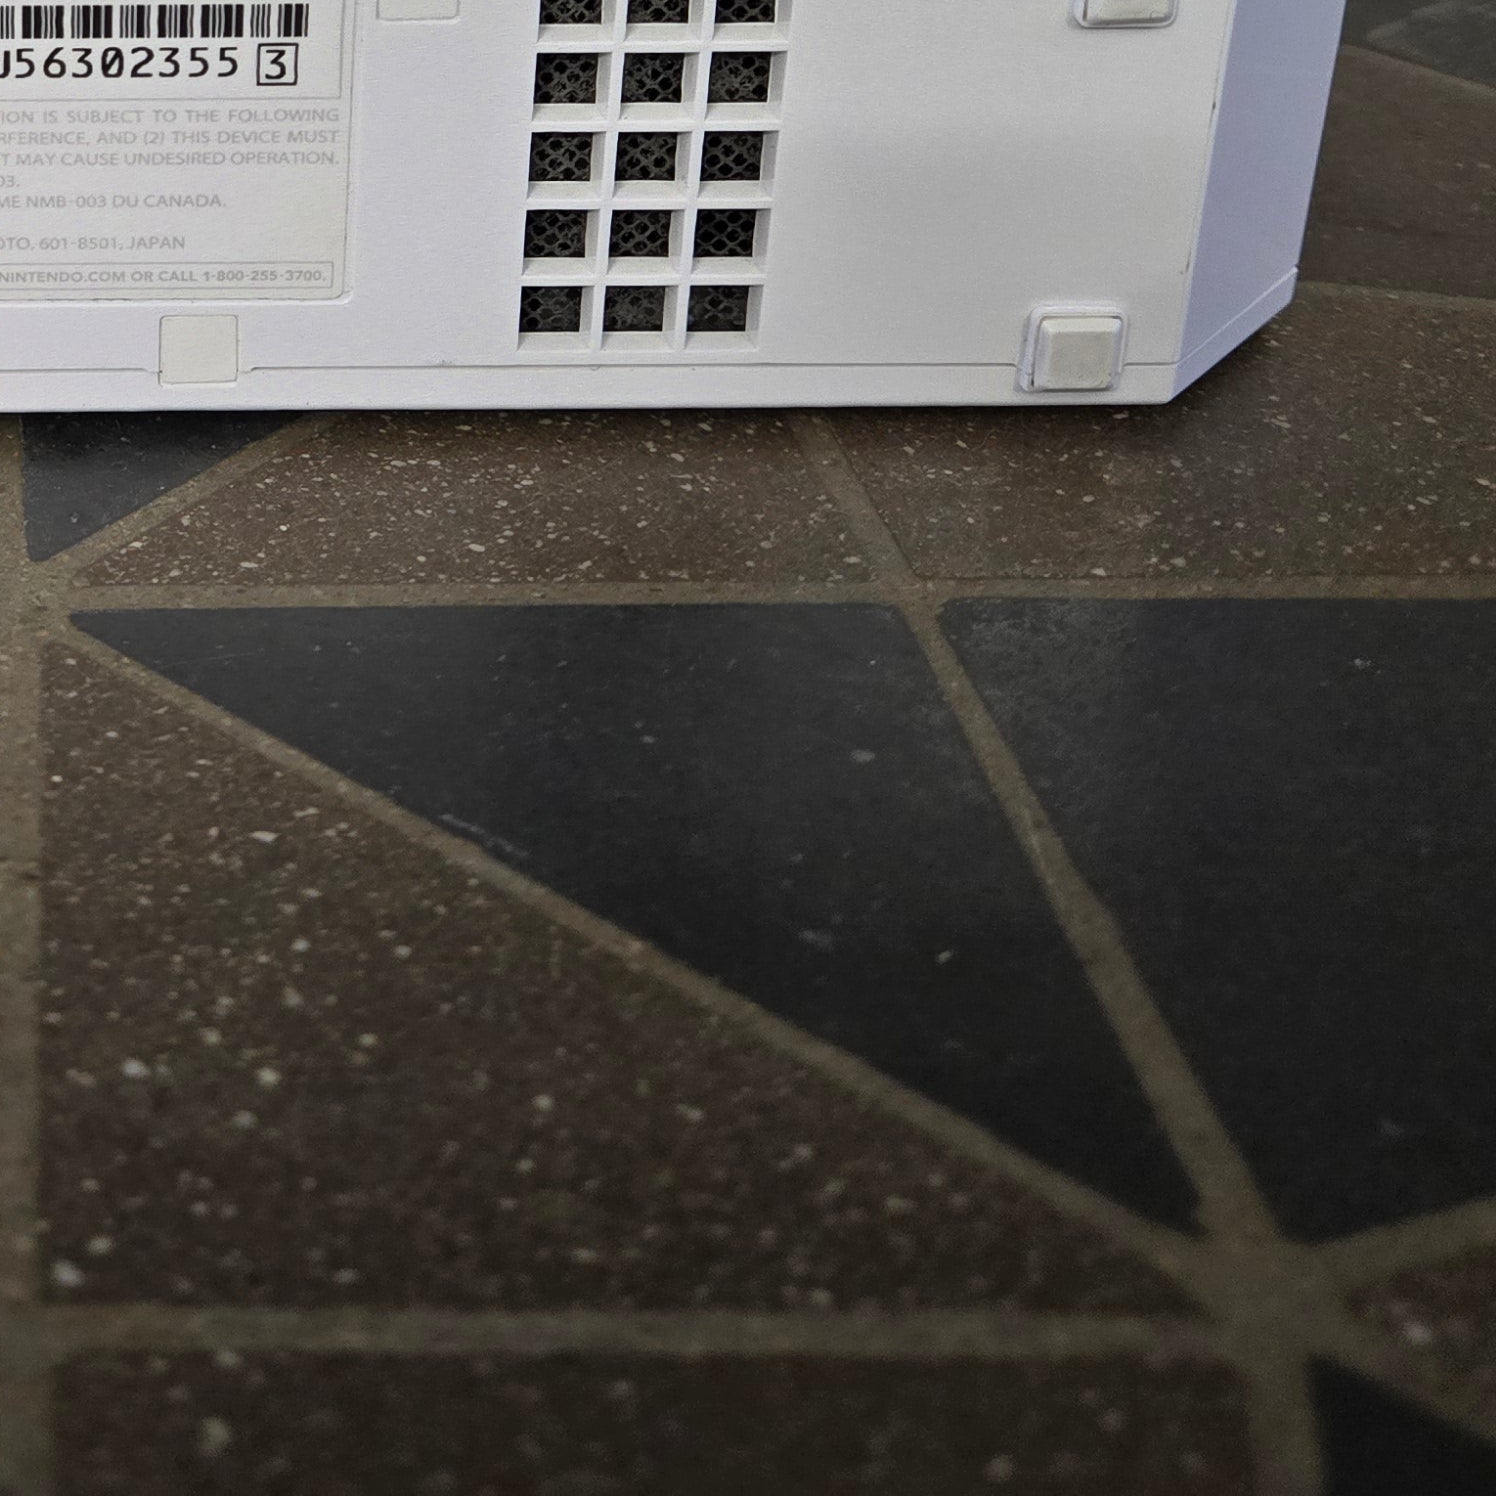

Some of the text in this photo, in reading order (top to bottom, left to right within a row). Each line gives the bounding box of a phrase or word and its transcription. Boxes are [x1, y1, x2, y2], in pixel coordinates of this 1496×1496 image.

[264, 51, 287, 78] 3
[42, 110, 58, 125] IS
[66, 109, 145, 124] SUBJECT
[152, 109, 178, 123] TO
[184, 108, 220, 123] THE
[227, 108, 340, 123] FOLLOWING
[96, 130, 138, 145] AND
[143, 130, 166, 145] (2)
[171, 131, 211, 145] THIS
[216, 130, 281, 145] DEVICE
[286, 130, 341, 144] MUST
[15, 154, 57, 167] MAY
[59, 152, 120, 167] CAUSE
[123, 151, 227, 166] UNDESIRED
[25, 194, 108, 209] NMB-003
[111, 194, 140, 208] DU
[127, 236, 186, 250] JAPAN
[130, 270, 154, 282] OR
[157, 270, 198, 282] CALL
